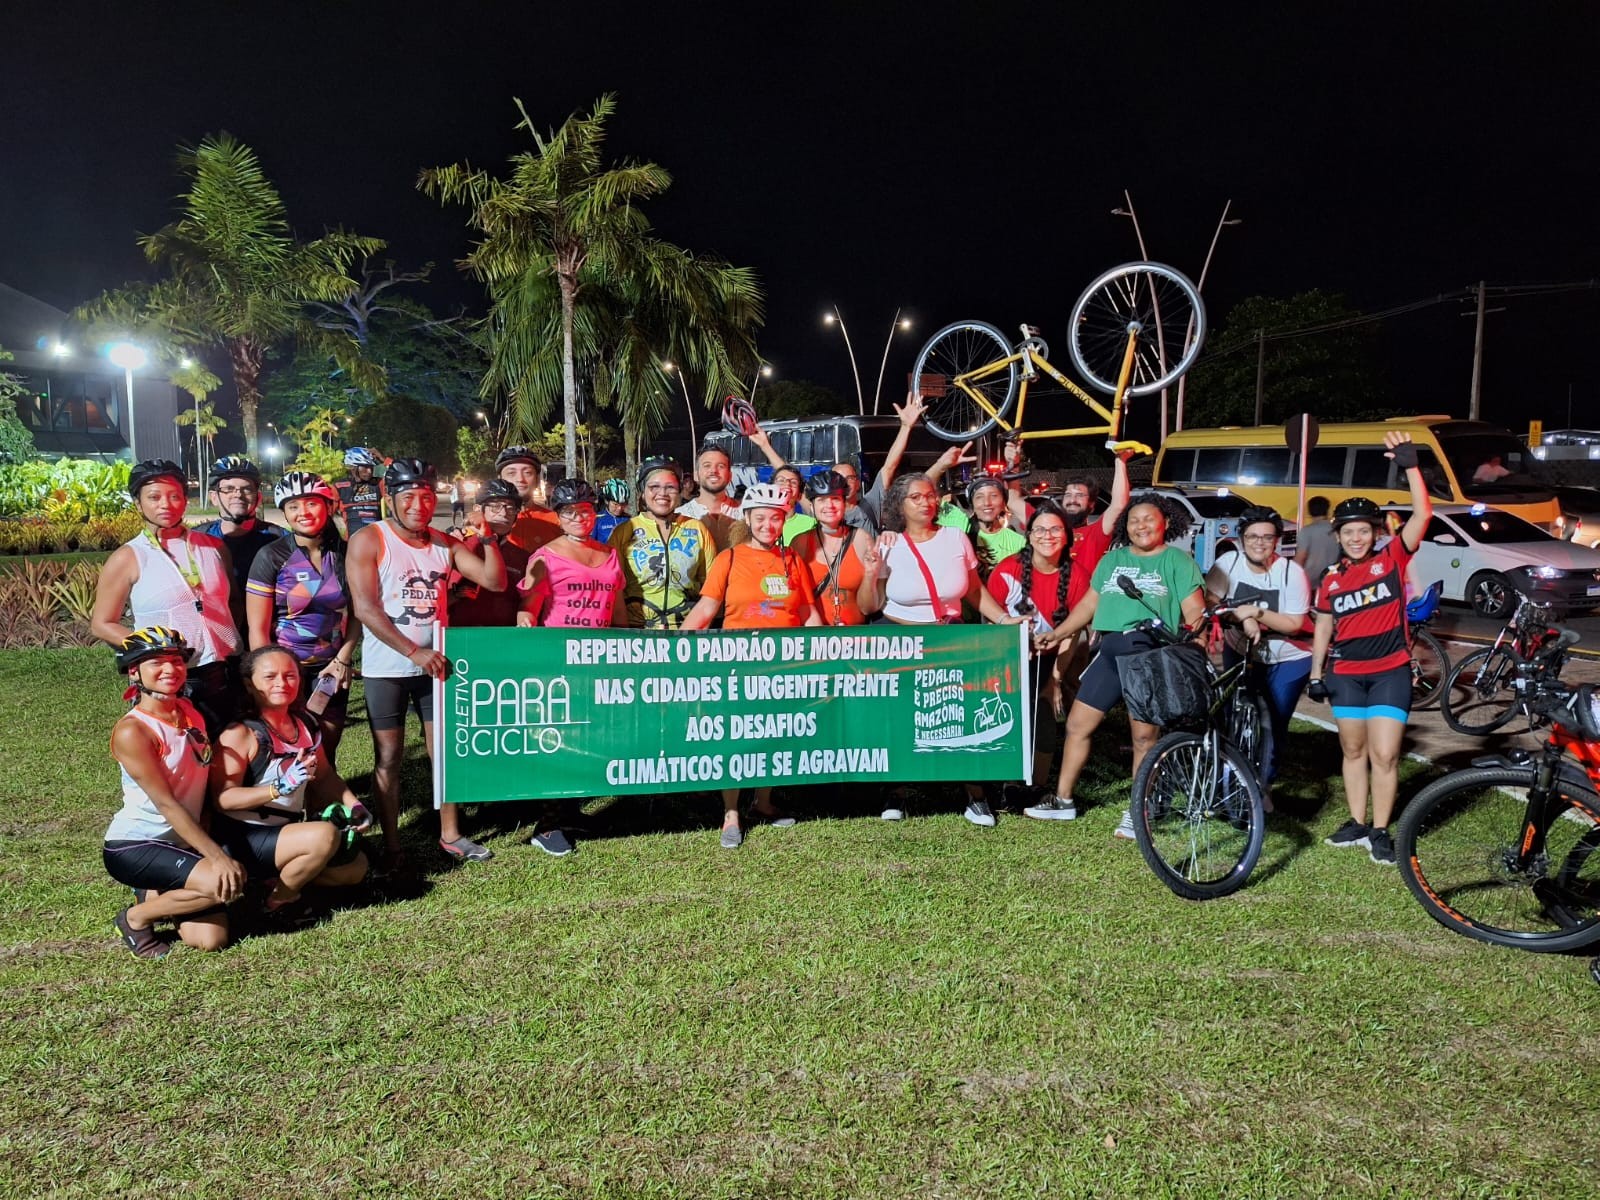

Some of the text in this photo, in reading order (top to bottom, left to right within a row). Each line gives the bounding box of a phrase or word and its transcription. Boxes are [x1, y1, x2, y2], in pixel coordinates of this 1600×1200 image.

[402, 589, 438, 600] PEDAL
[567, 597, 601, 609] solta
[1334, 582, 1392, 613] CAIXA
[564, 615, 591, 626] tua
[566, 631, 924, 665] REPENSAR O PADRÃO DE MOBILIDADE
[594, 668, 900, 705] NAS CIDADES É URGENTE FRENTE
[914, 668, 964, 688] PEDALAR
[455, 658, 469, 758] COLETIVO
[470, 675, 571, 727] PARÁ
[914, 684, 964, 709] É PRECISO
[685, 711, 817, 742] AOS DESAFIOS
[914, 702, 965, 729] AMAZÔNIA
[471, 727, 562, 756] CICLO
[921, 723, 964, 741] NECESSÁRIA!
[606, 747, 889, 786] CLIMÁTICOS QUE SE AGRAVAM
